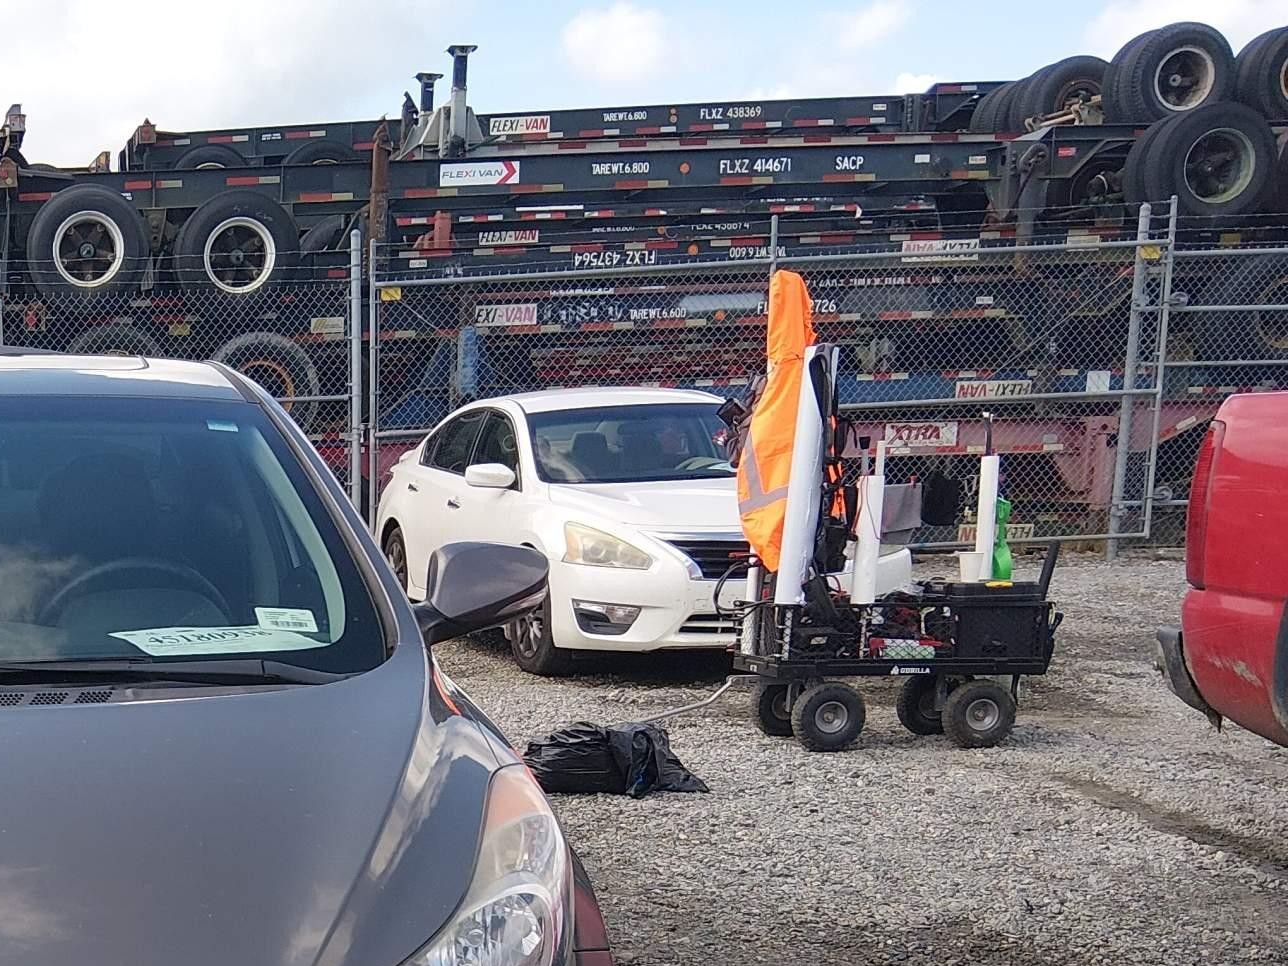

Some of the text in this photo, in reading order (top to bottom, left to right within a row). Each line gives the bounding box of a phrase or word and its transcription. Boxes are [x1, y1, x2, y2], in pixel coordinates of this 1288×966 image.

[700, 106, 762, 120] FLXZ 438369
[491, 118, 548, 133] FLEXI-VAN
[720, 158, 792, 174] FLXZ 414671
[835, 156, 864, 170] SACP
[442, 169, 504, 179] FLEXI VAN
[574, 250, 656, 267] FLXZ 437564
